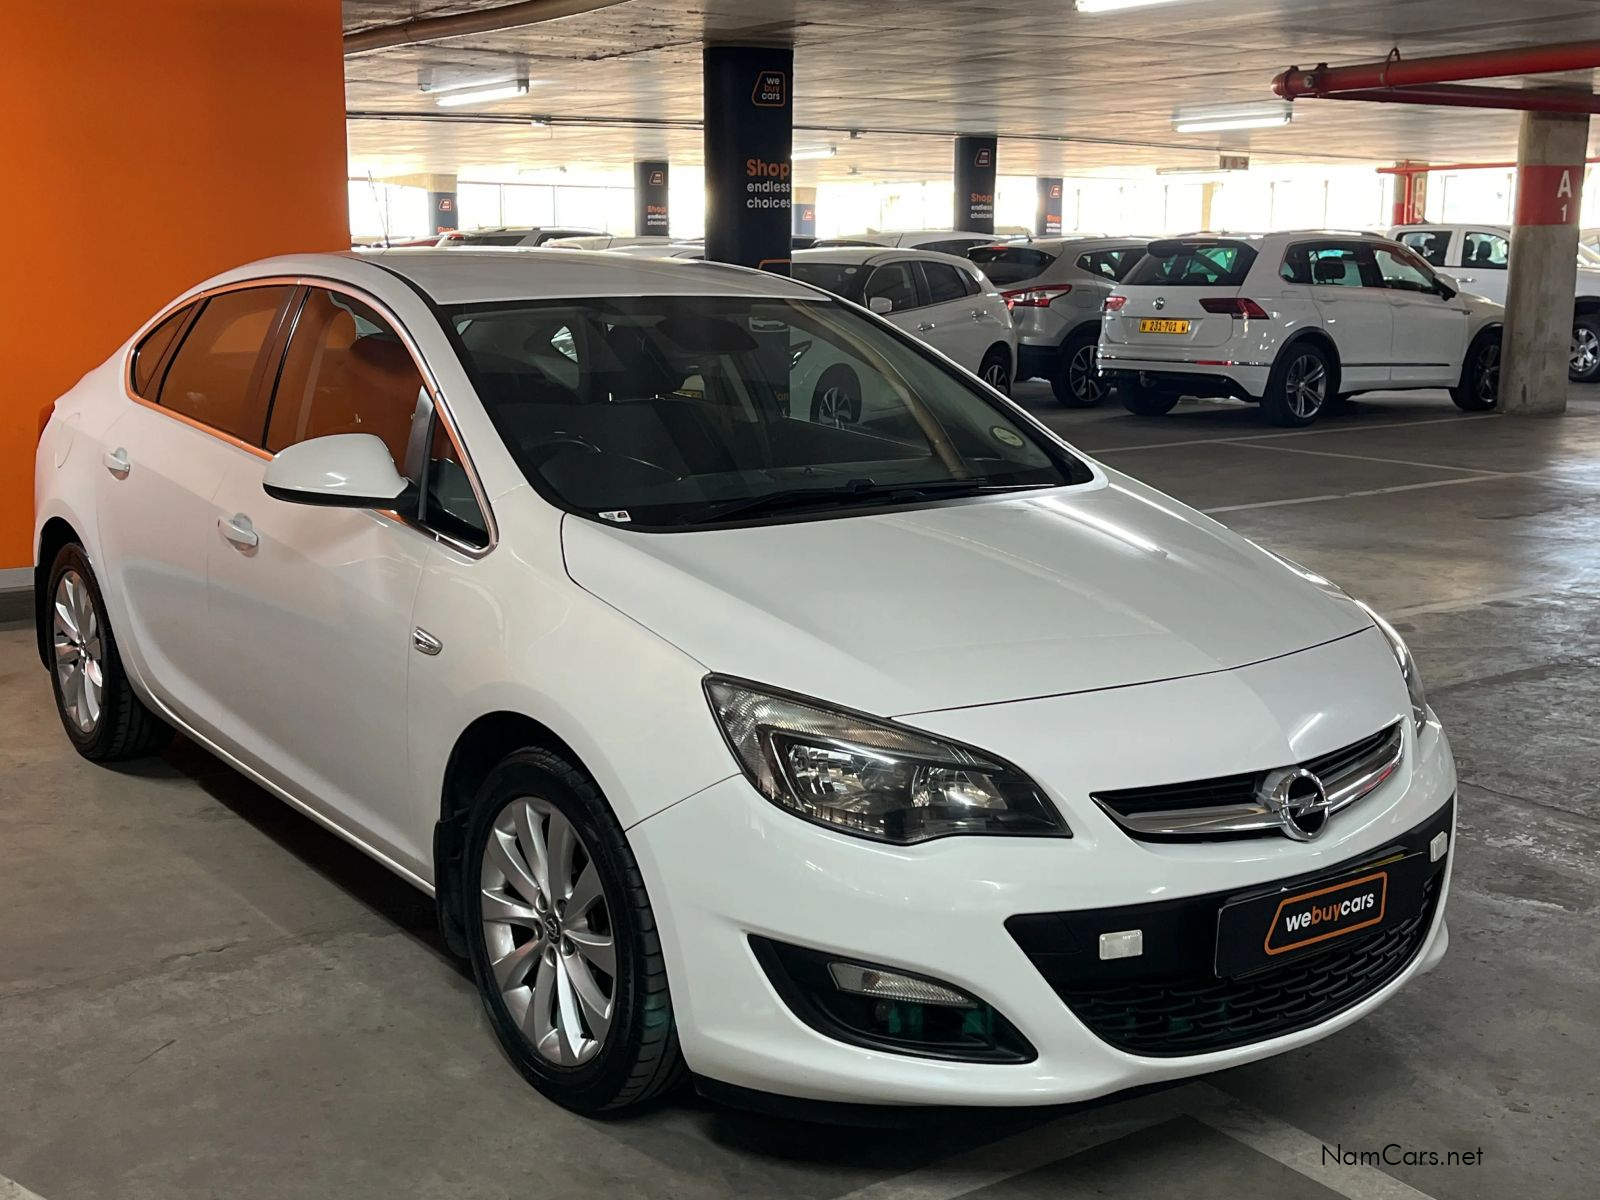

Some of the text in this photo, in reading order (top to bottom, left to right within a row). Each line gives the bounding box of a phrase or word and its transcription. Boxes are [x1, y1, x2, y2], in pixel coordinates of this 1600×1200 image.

[766, 77, 780, 85] we
[764, 83, 780, 94] buy
[746, 159, 790, 180] Shop
[746, 181, 791, 192] endless
[1557, 170, 1572, 198] A
[746, 197, 791, 208] choices
[971, 193, 992, 203] Shop
[1561, 204, 1568, 222] 1
[1285, 892, 1375, 932] webuycars
